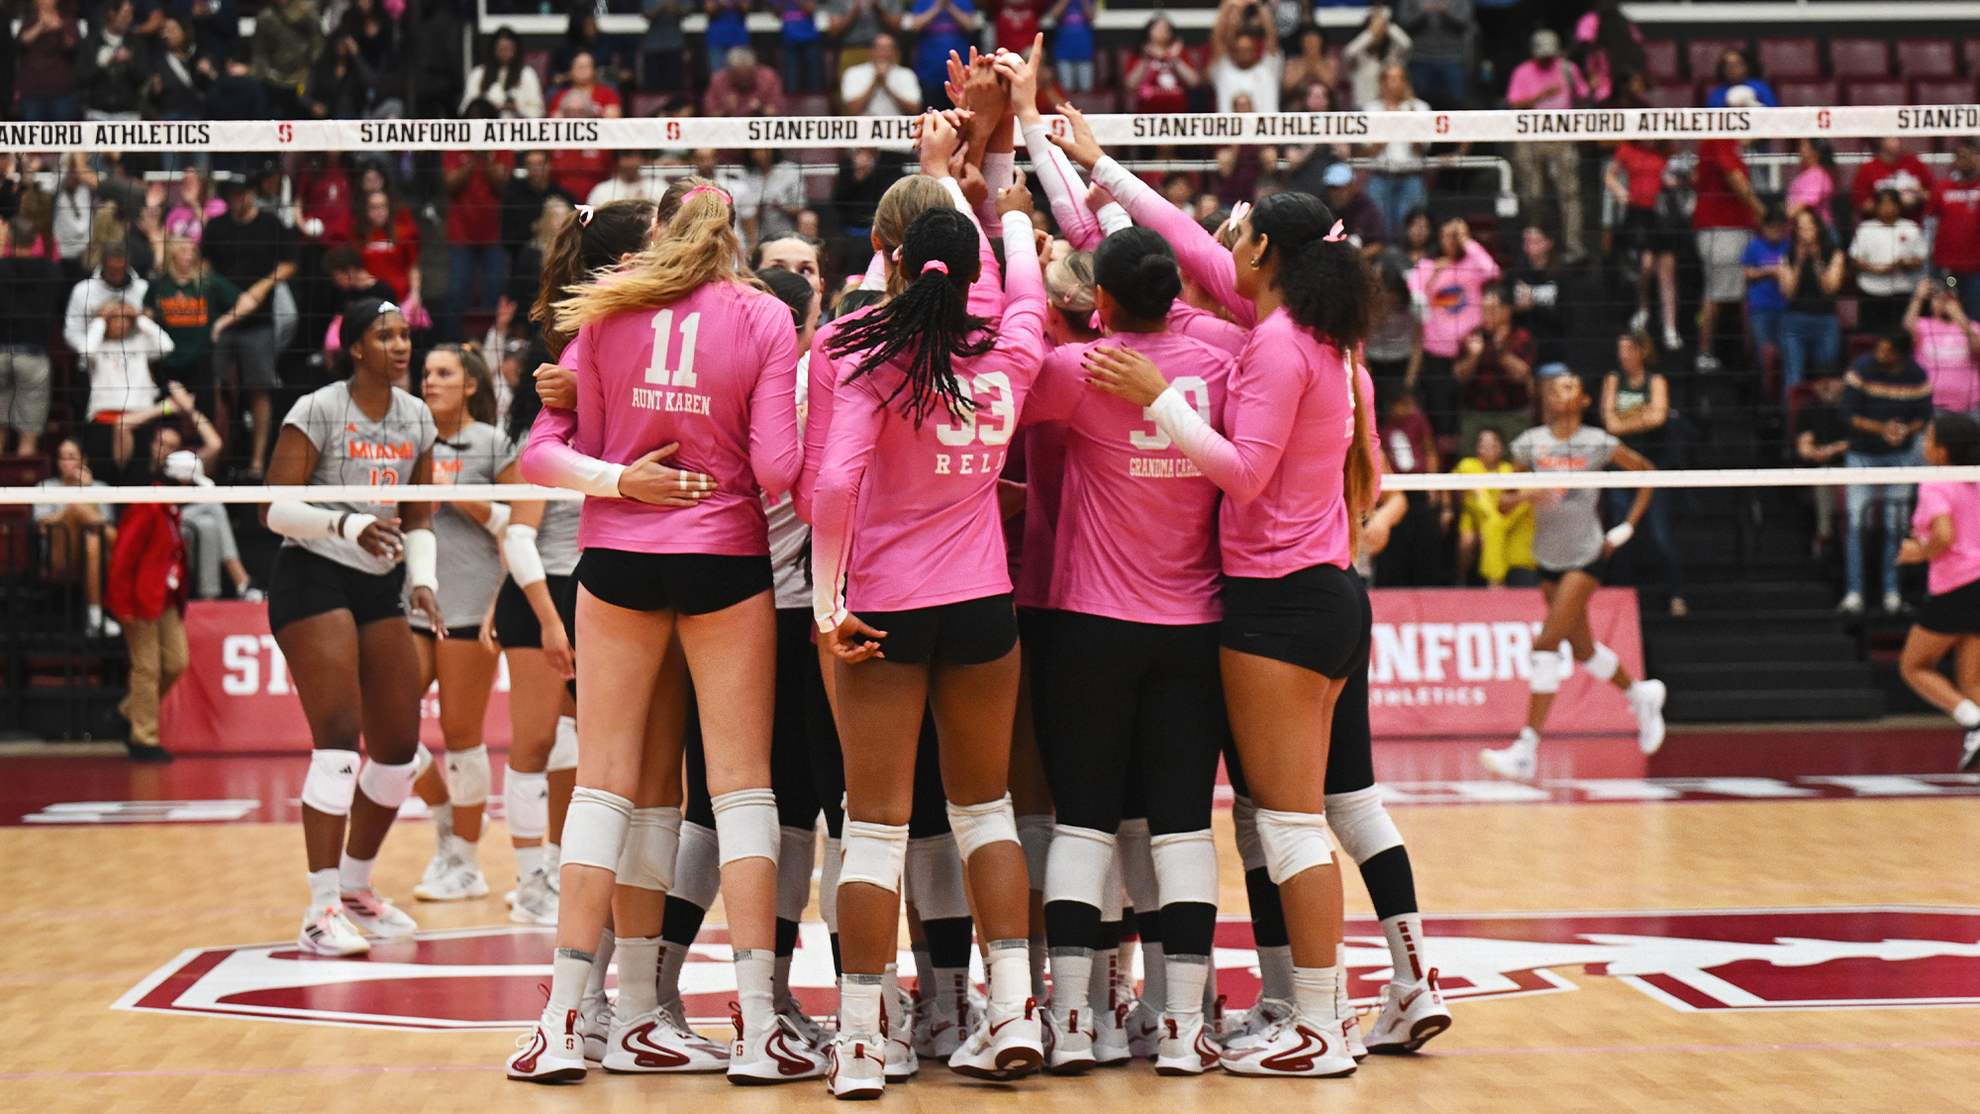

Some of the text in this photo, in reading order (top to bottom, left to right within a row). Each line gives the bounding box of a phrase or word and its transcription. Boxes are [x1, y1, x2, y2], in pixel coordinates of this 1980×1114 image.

[1133, 114, 1368, 137] STANFORD ATHLETICS
[1516, 110, 1751, 134] STANFORD ATHLETICS
[1898, 108, 1980, 129] STANFO
[0, 123, 210, 145] ANFORD ATHLETICS
[360, 120, 599, 143] STANFORD ATHLETICS
[748, 119, 917, 141] STANFORD ATH
[644, 308, 701, 388] 11
[632, 387, 712, 415] AUNT KAREN
[349, 439, 414, 461] MIAMI
[1129, 457, 1175, 478] GRANDMA
[1368, 621, 1574, 683] NFOR
[1369, 686, 1487, 706] THLETICS
